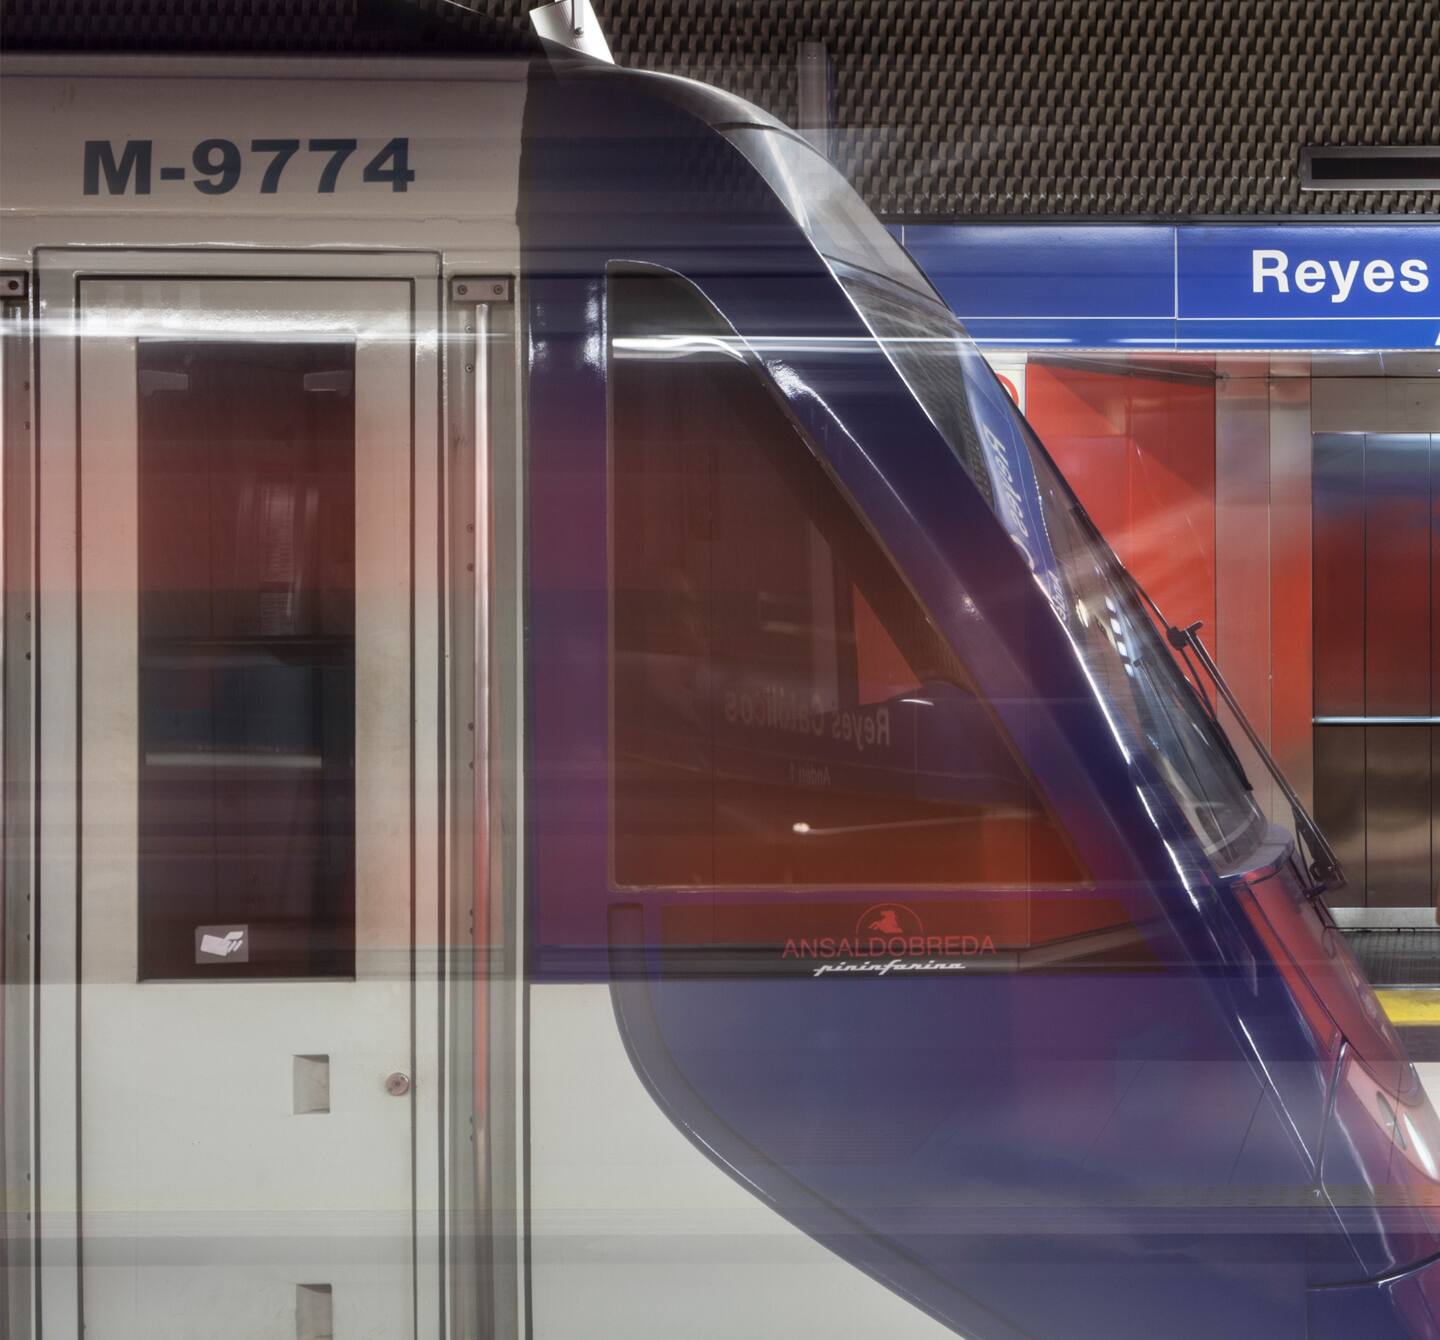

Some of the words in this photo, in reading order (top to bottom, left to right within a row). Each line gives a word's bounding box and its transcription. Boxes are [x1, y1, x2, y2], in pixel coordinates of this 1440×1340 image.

[83, 138, 416, 195] M-9774
[1252, 249, 1428, 303] Reyes
[782, 936, 997, 958] ANSALDOBREDA
[813, 959, 966, 977] pininfarina
